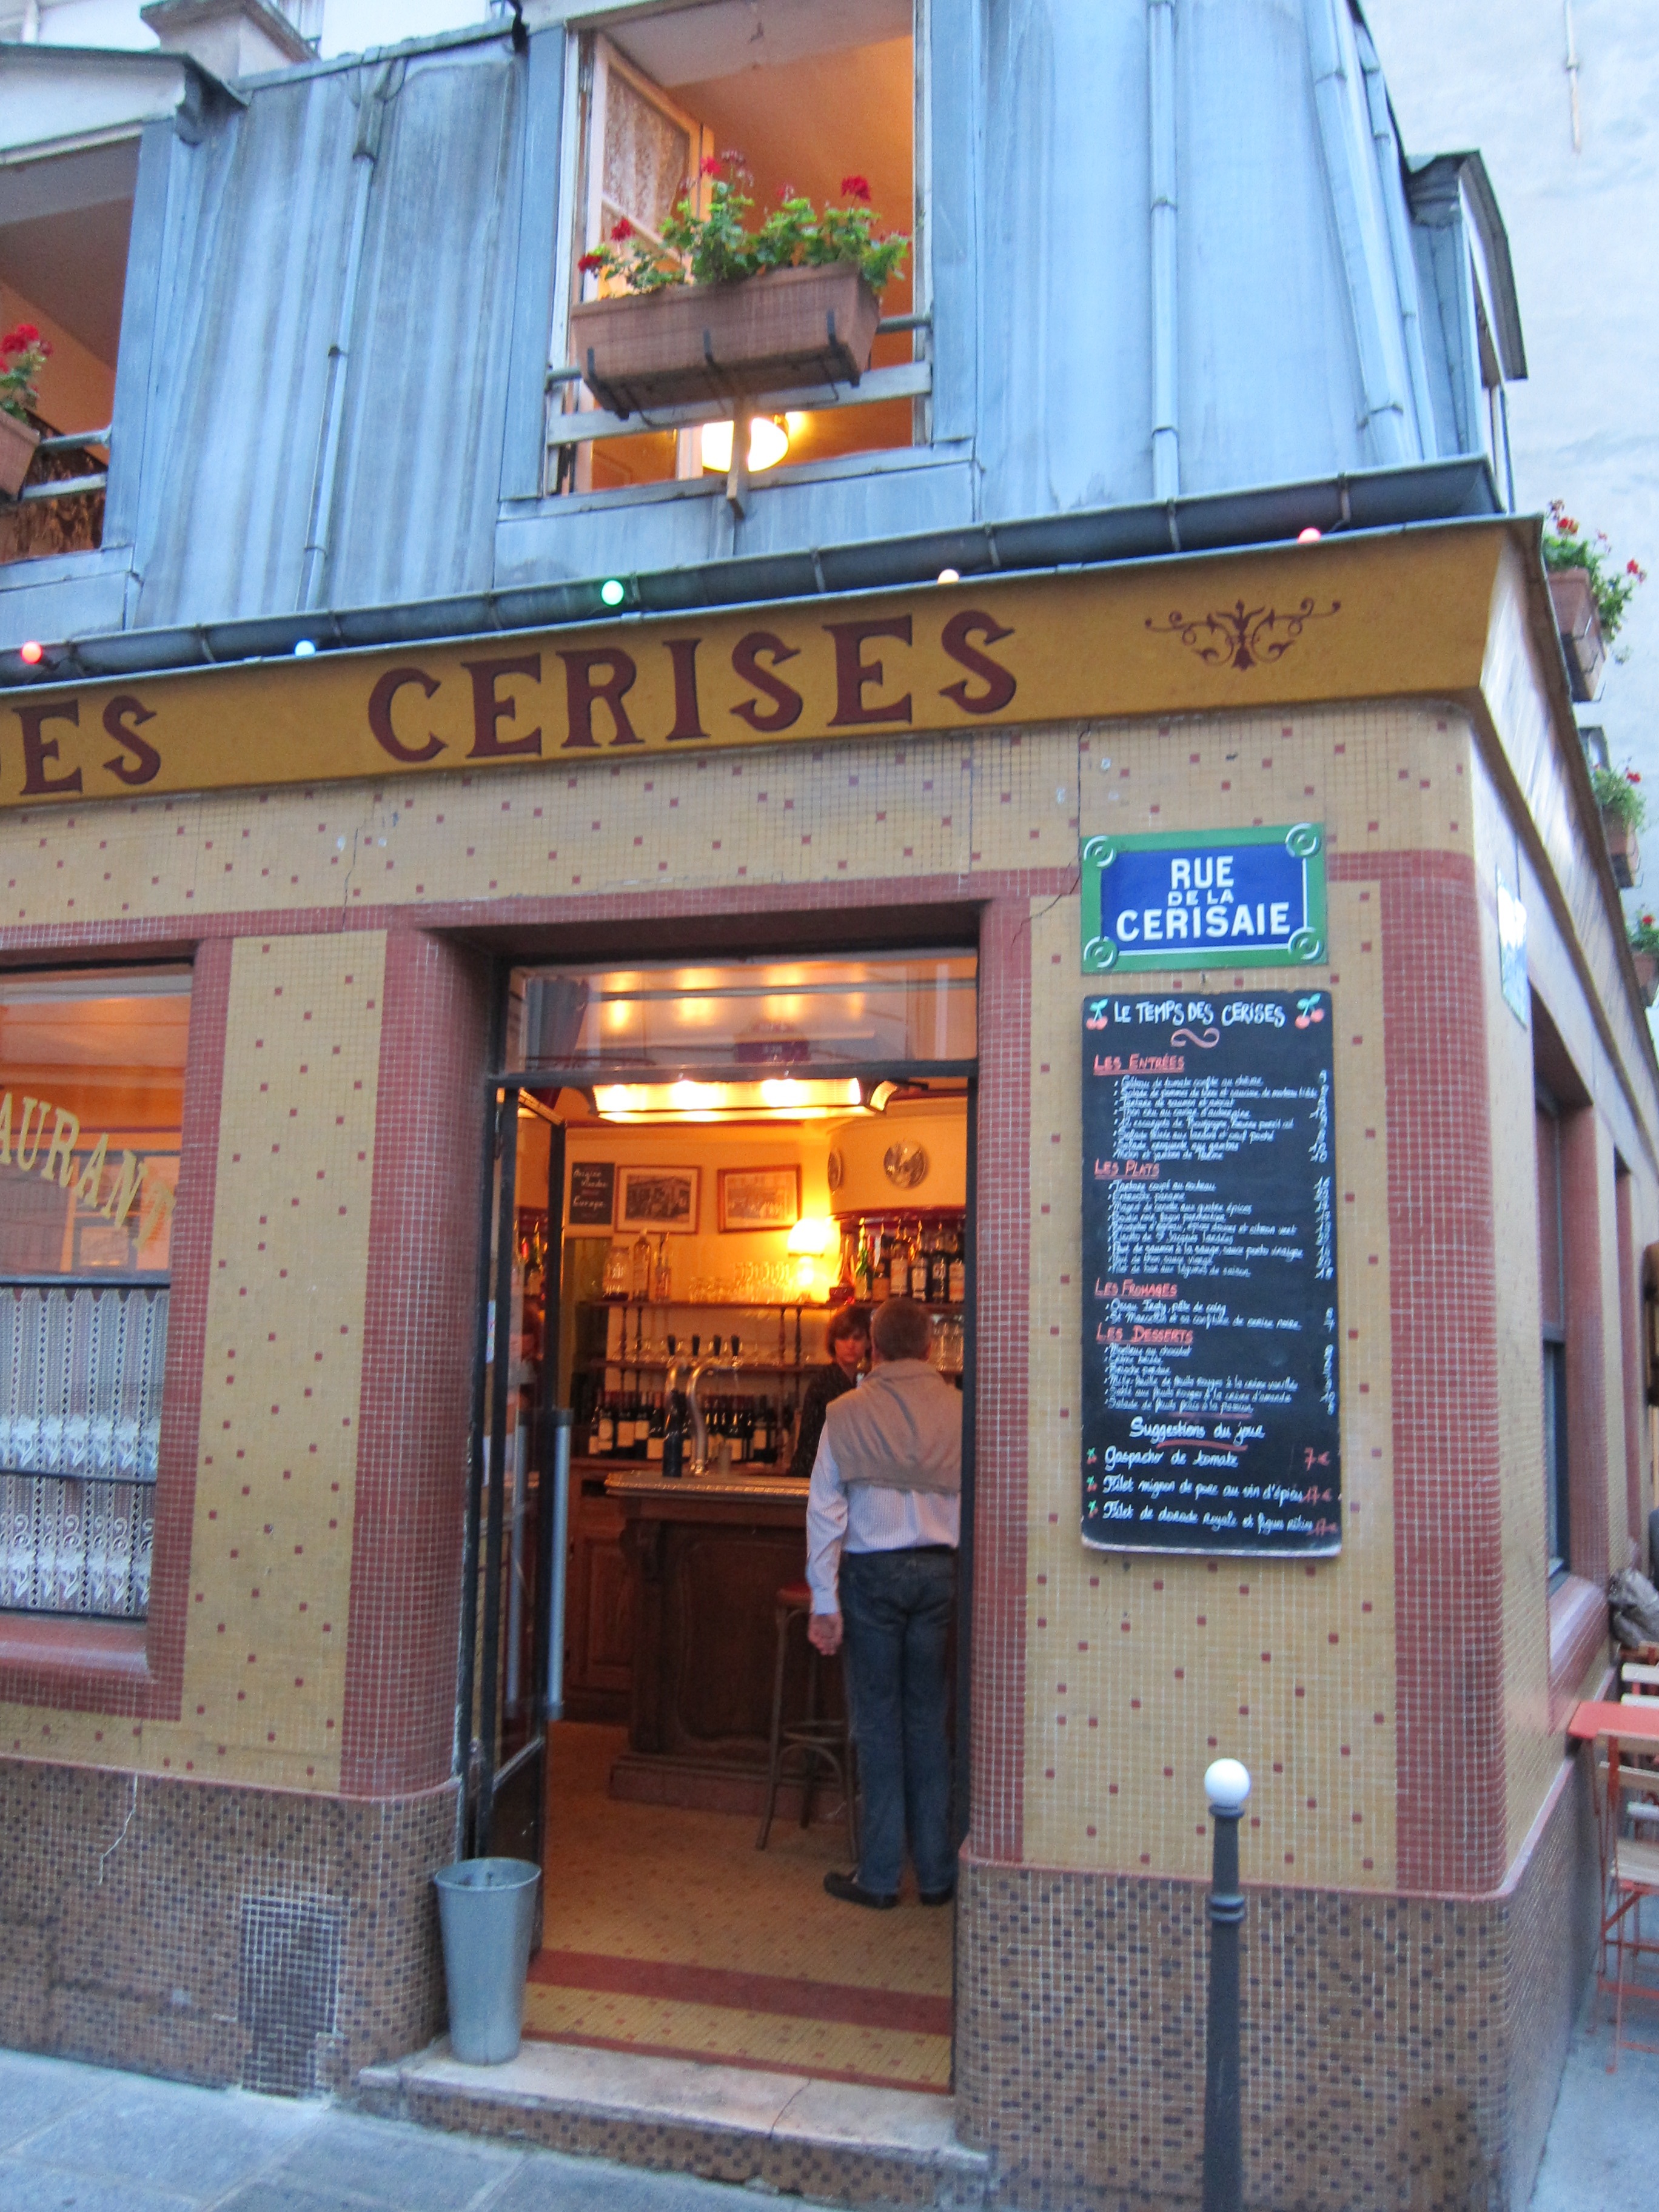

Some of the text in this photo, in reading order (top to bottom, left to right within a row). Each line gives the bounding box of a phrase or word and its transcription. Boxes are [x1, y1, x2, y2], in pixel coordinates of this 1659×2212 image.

[12, 609, 1017, 796] ES CERISES
[1171, 856, 1234, 890] RUE
[1167, 889, 1234, 907] DE LA
[1116, 902, 1290, 942] CERISAIE
[1135, 1000, 1184, 1026] TEMPS
[1188, 1000, 1213, 1025] DES
[1221, 999, 1286, 1028] CERISES
[1094, 1054, 1121, 1071] LES
[1094, 1159, 1160, 1176] LES PLATS
[1094, 1277, 1178, 1298] LES FROMAGES
[1193, 1302, 1204, 1313] de
[1232, 1315, 1244, 1327] de
[1096, 1322, 1193, 1344] LES DESSERTS
[1141, 1399, 1153, 1410] de
[1209, 1399, 1218, 1412] la
[1129, 1416, 1265, 1446] Suggestions du jour
[1104, 1446, 1164, 1471] Gaspacho
[1171, 1449, 1187, 1465] de
[1192, 1450, 1238, 1467] tomate
[1102, 1473, 1134, 1493] Filet
[1138, 1478, 1175, 1500] mignon
[1179, 1478, 1193, 1493] de
[1195, 1483, 1219, 1500] porc
[1222, 1485, 1239, 1497] au
[1242, 1484, 1260, 1498] vin
[1262, 1484, 1303, 1507] d'épices
[1102, 1500, 1134, 1519] Filet
[1140, 1505, 1153, 1521] de
[1202, 1510, 1238, 1532] royale
[1242, 1513, 1253, 1528] et
[1258, 1512, 1285, 1535] figues
